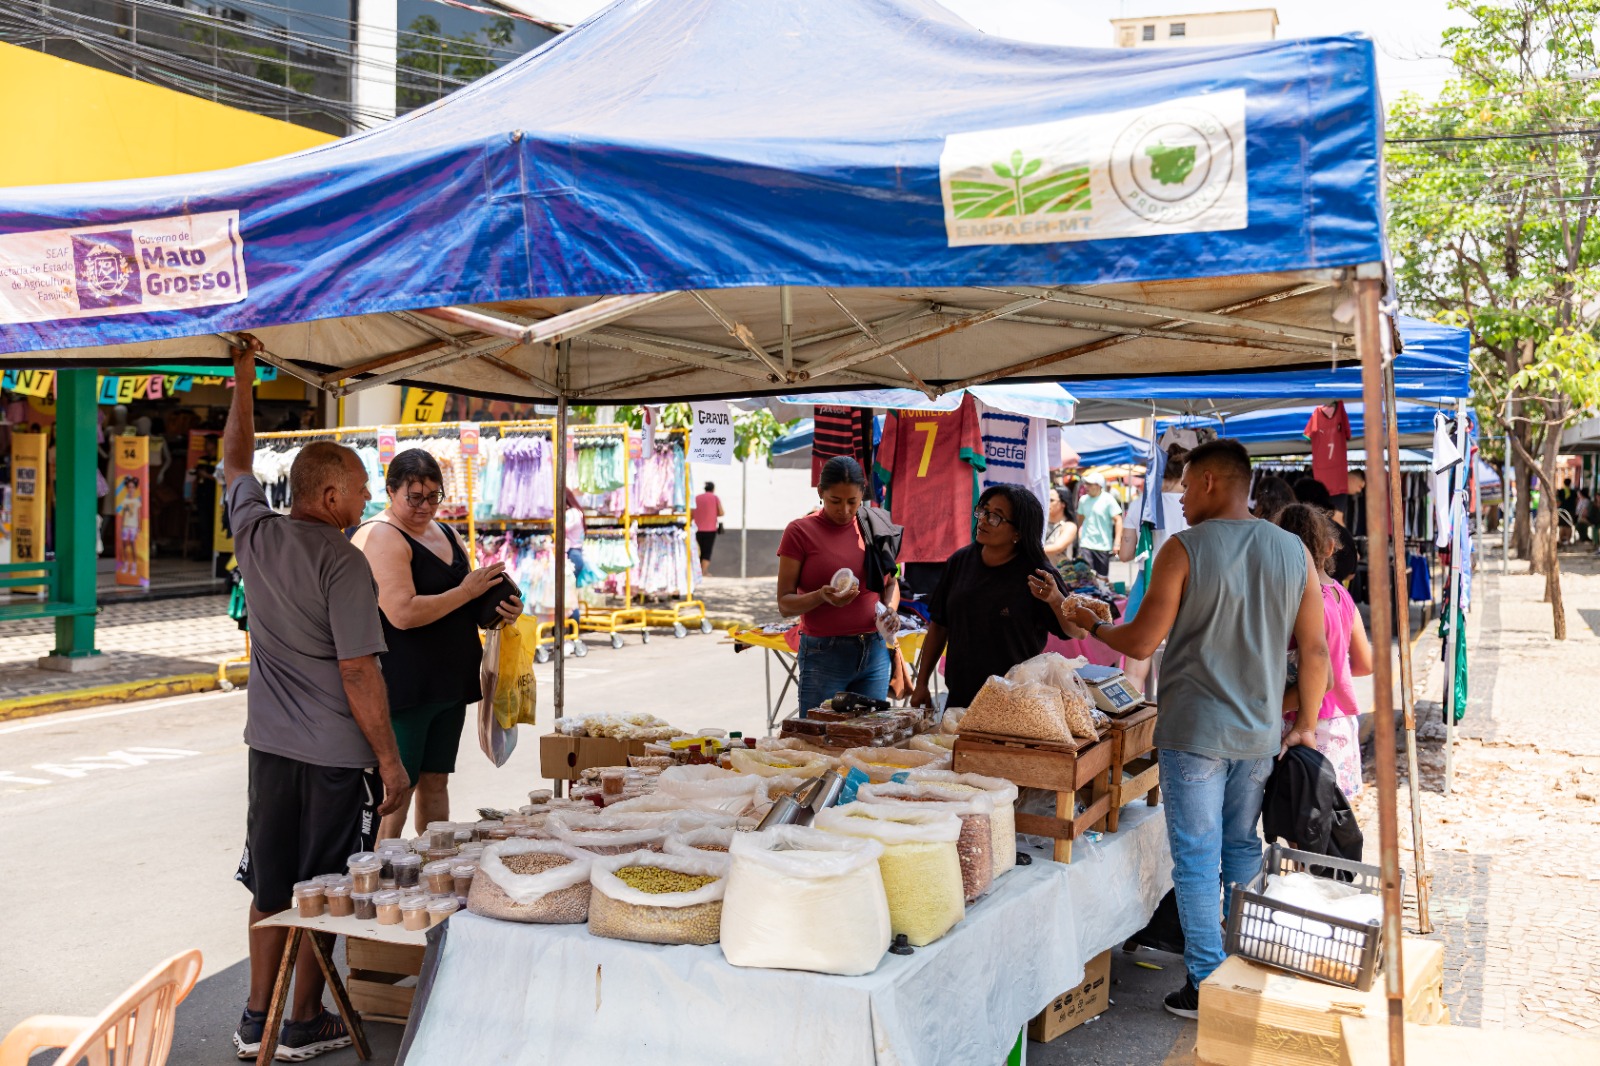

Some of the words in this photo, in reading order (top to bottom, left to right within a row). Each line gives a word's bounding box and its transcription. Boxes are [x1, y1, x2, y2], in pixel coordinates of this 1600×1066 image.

[956, 215, 1093, 238] EMPAER-MT
[138, 234, 176, 245] Governo
[178, 231, 190, 241] de
[46, 246, 70, 259] SEAF
[142, 245, 206, 270] Mato
[43, 261, 74, 273] Estado
[11, 280, 22, 290] de
[146, 271, 231, 296] Grosso
[698, 410, 729, 425] GRAVA
[700, 437, 727, 445] nome
[915, 421, 939, 478] 7
[989, 443, 1027, 461] betfai
[1328, 443, 1335, 459] 7
[362, 809, 373, 835] NIKE
